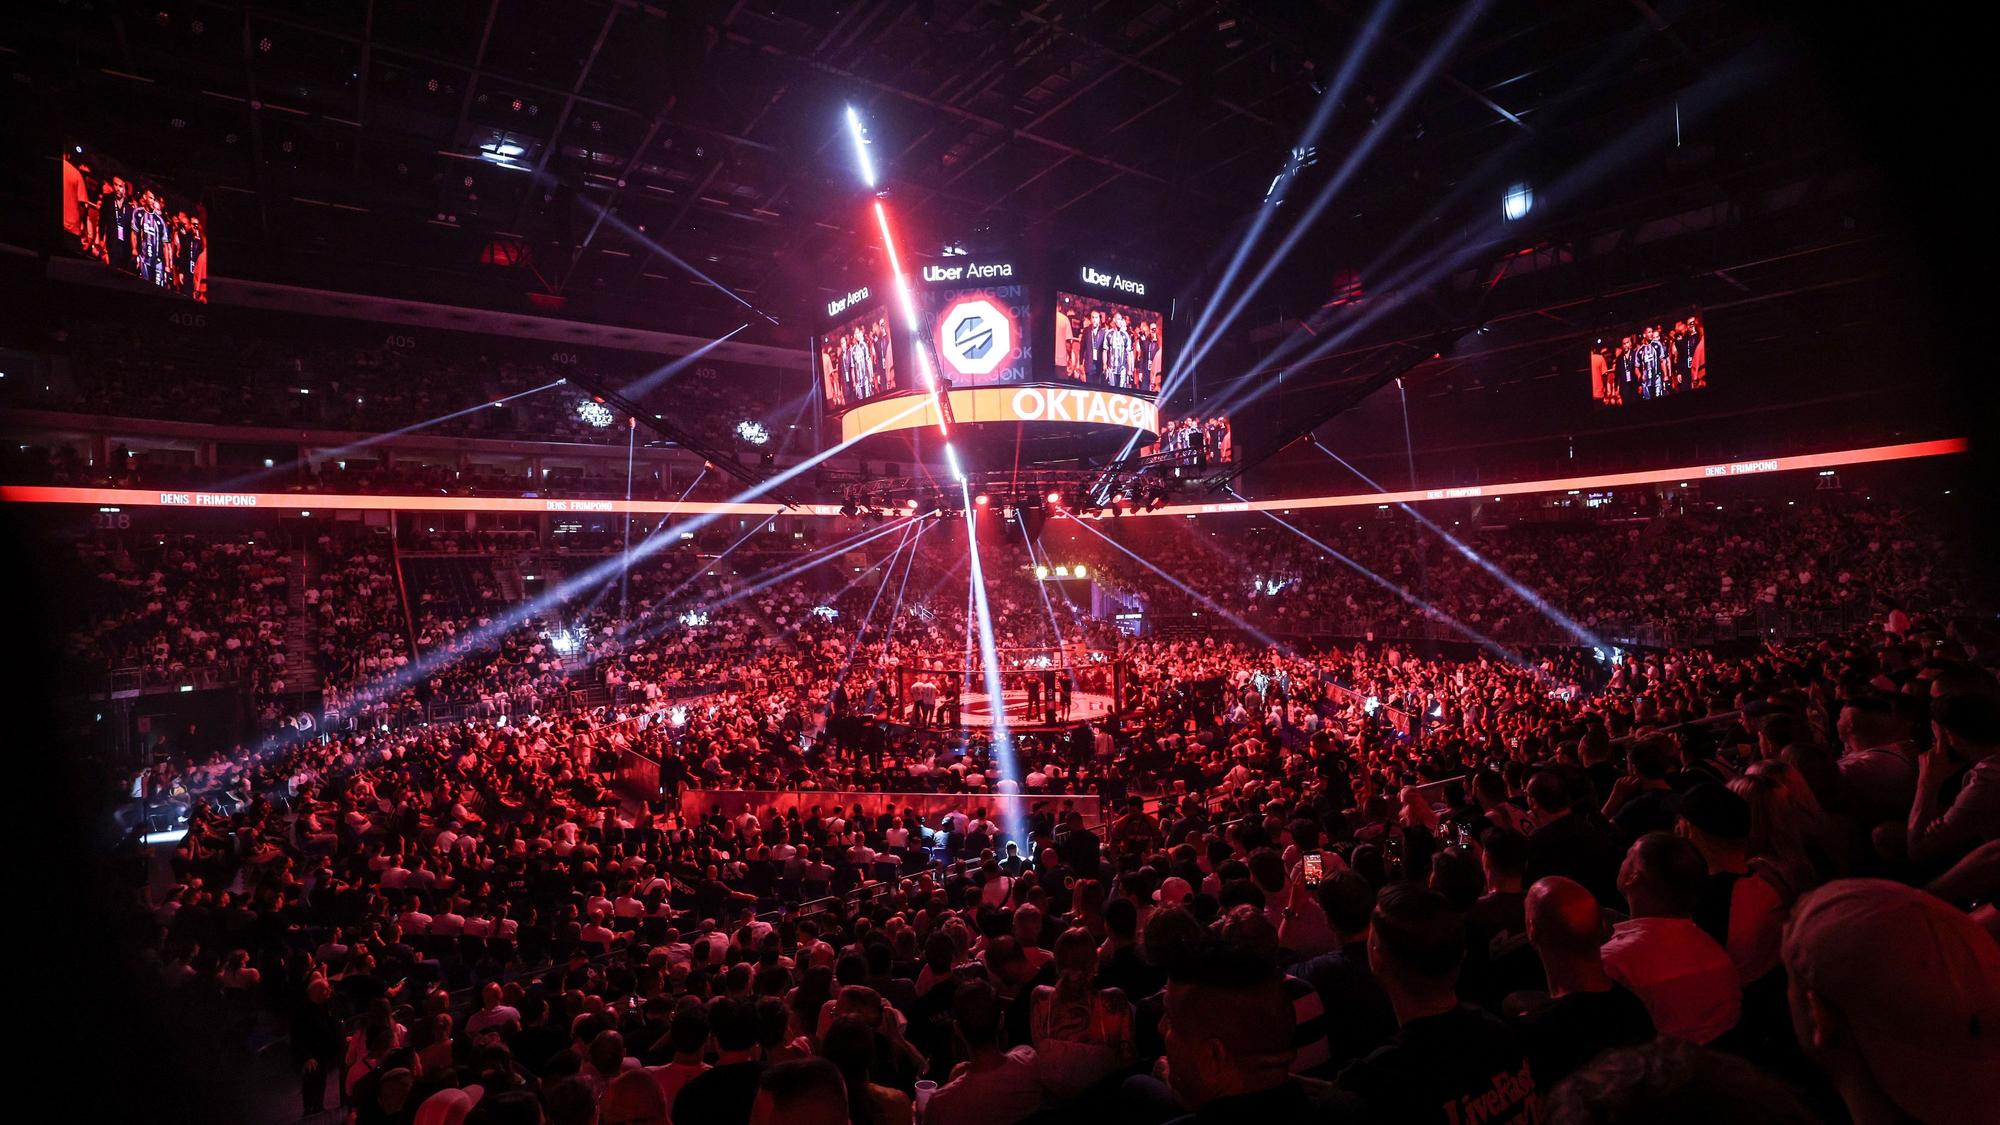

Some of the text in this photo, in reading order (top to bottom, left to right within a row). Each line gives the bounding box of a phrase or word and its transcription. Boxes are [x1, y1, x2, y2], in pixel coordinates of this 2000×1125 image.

[923, 263, 1012, 281] Uber Arena
[1082, 266, 1145, 295] Uber Arena
[828, 287, 869, 316] Uber Arena
[386, 335, 416, 348] 405
[552, 352, 577, 365] 404
[1012, 388, 1156, 431] OKTAGON
[1705, 460, 1778, 476] DENIS FRIMPONG
[1816, 476, 1842, 490] 211
[161, 493, 257, 506] DENIS FRIMPONG
